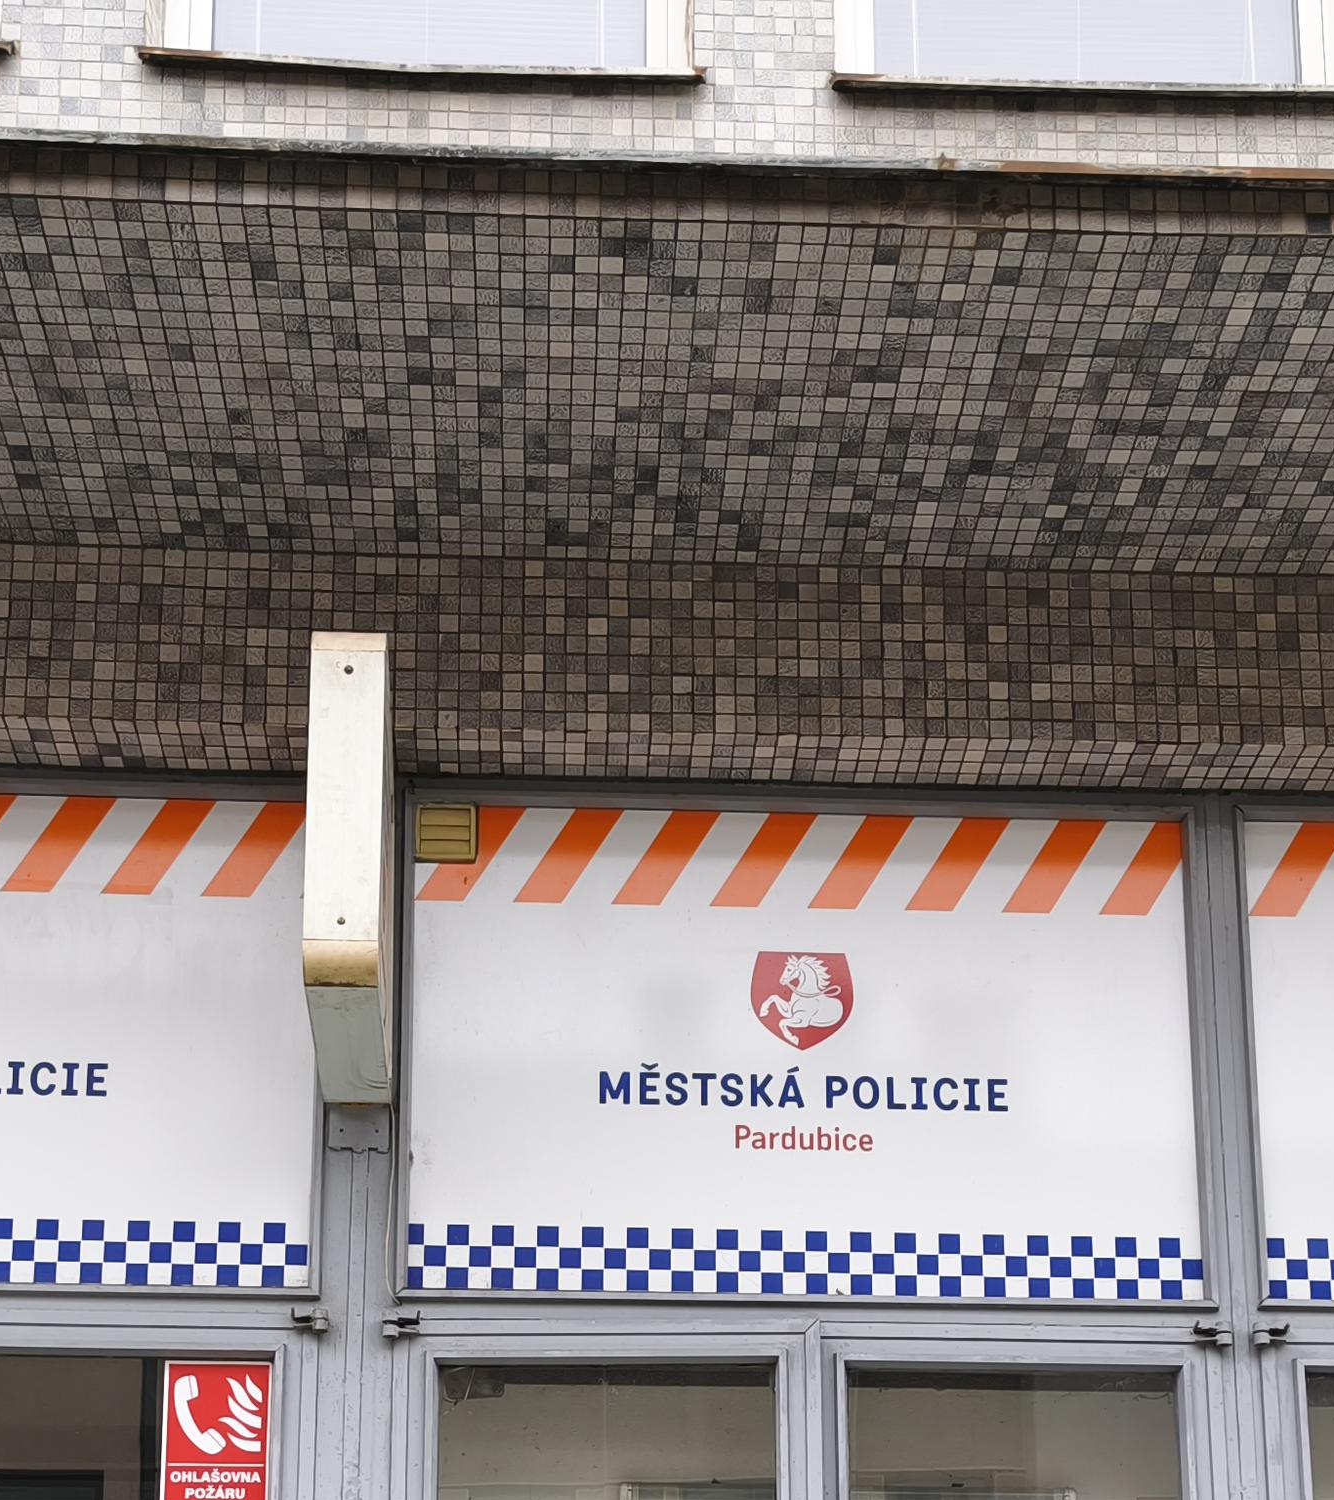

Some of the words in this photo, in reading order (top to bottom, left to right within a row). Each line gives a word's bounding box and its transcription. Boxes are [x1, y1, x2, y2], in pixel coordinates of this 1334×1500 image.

[599, 1062, 805, 1108] MĚSTSKÁ
[825, 1075, 1009, 1112] POLICIE
[734, 1124, 873, 1151] Pardubice
[170, 1467, 261, 1485] OHLAŠOVNA
[184, 1484, 246, 1500] POŽÁRU
